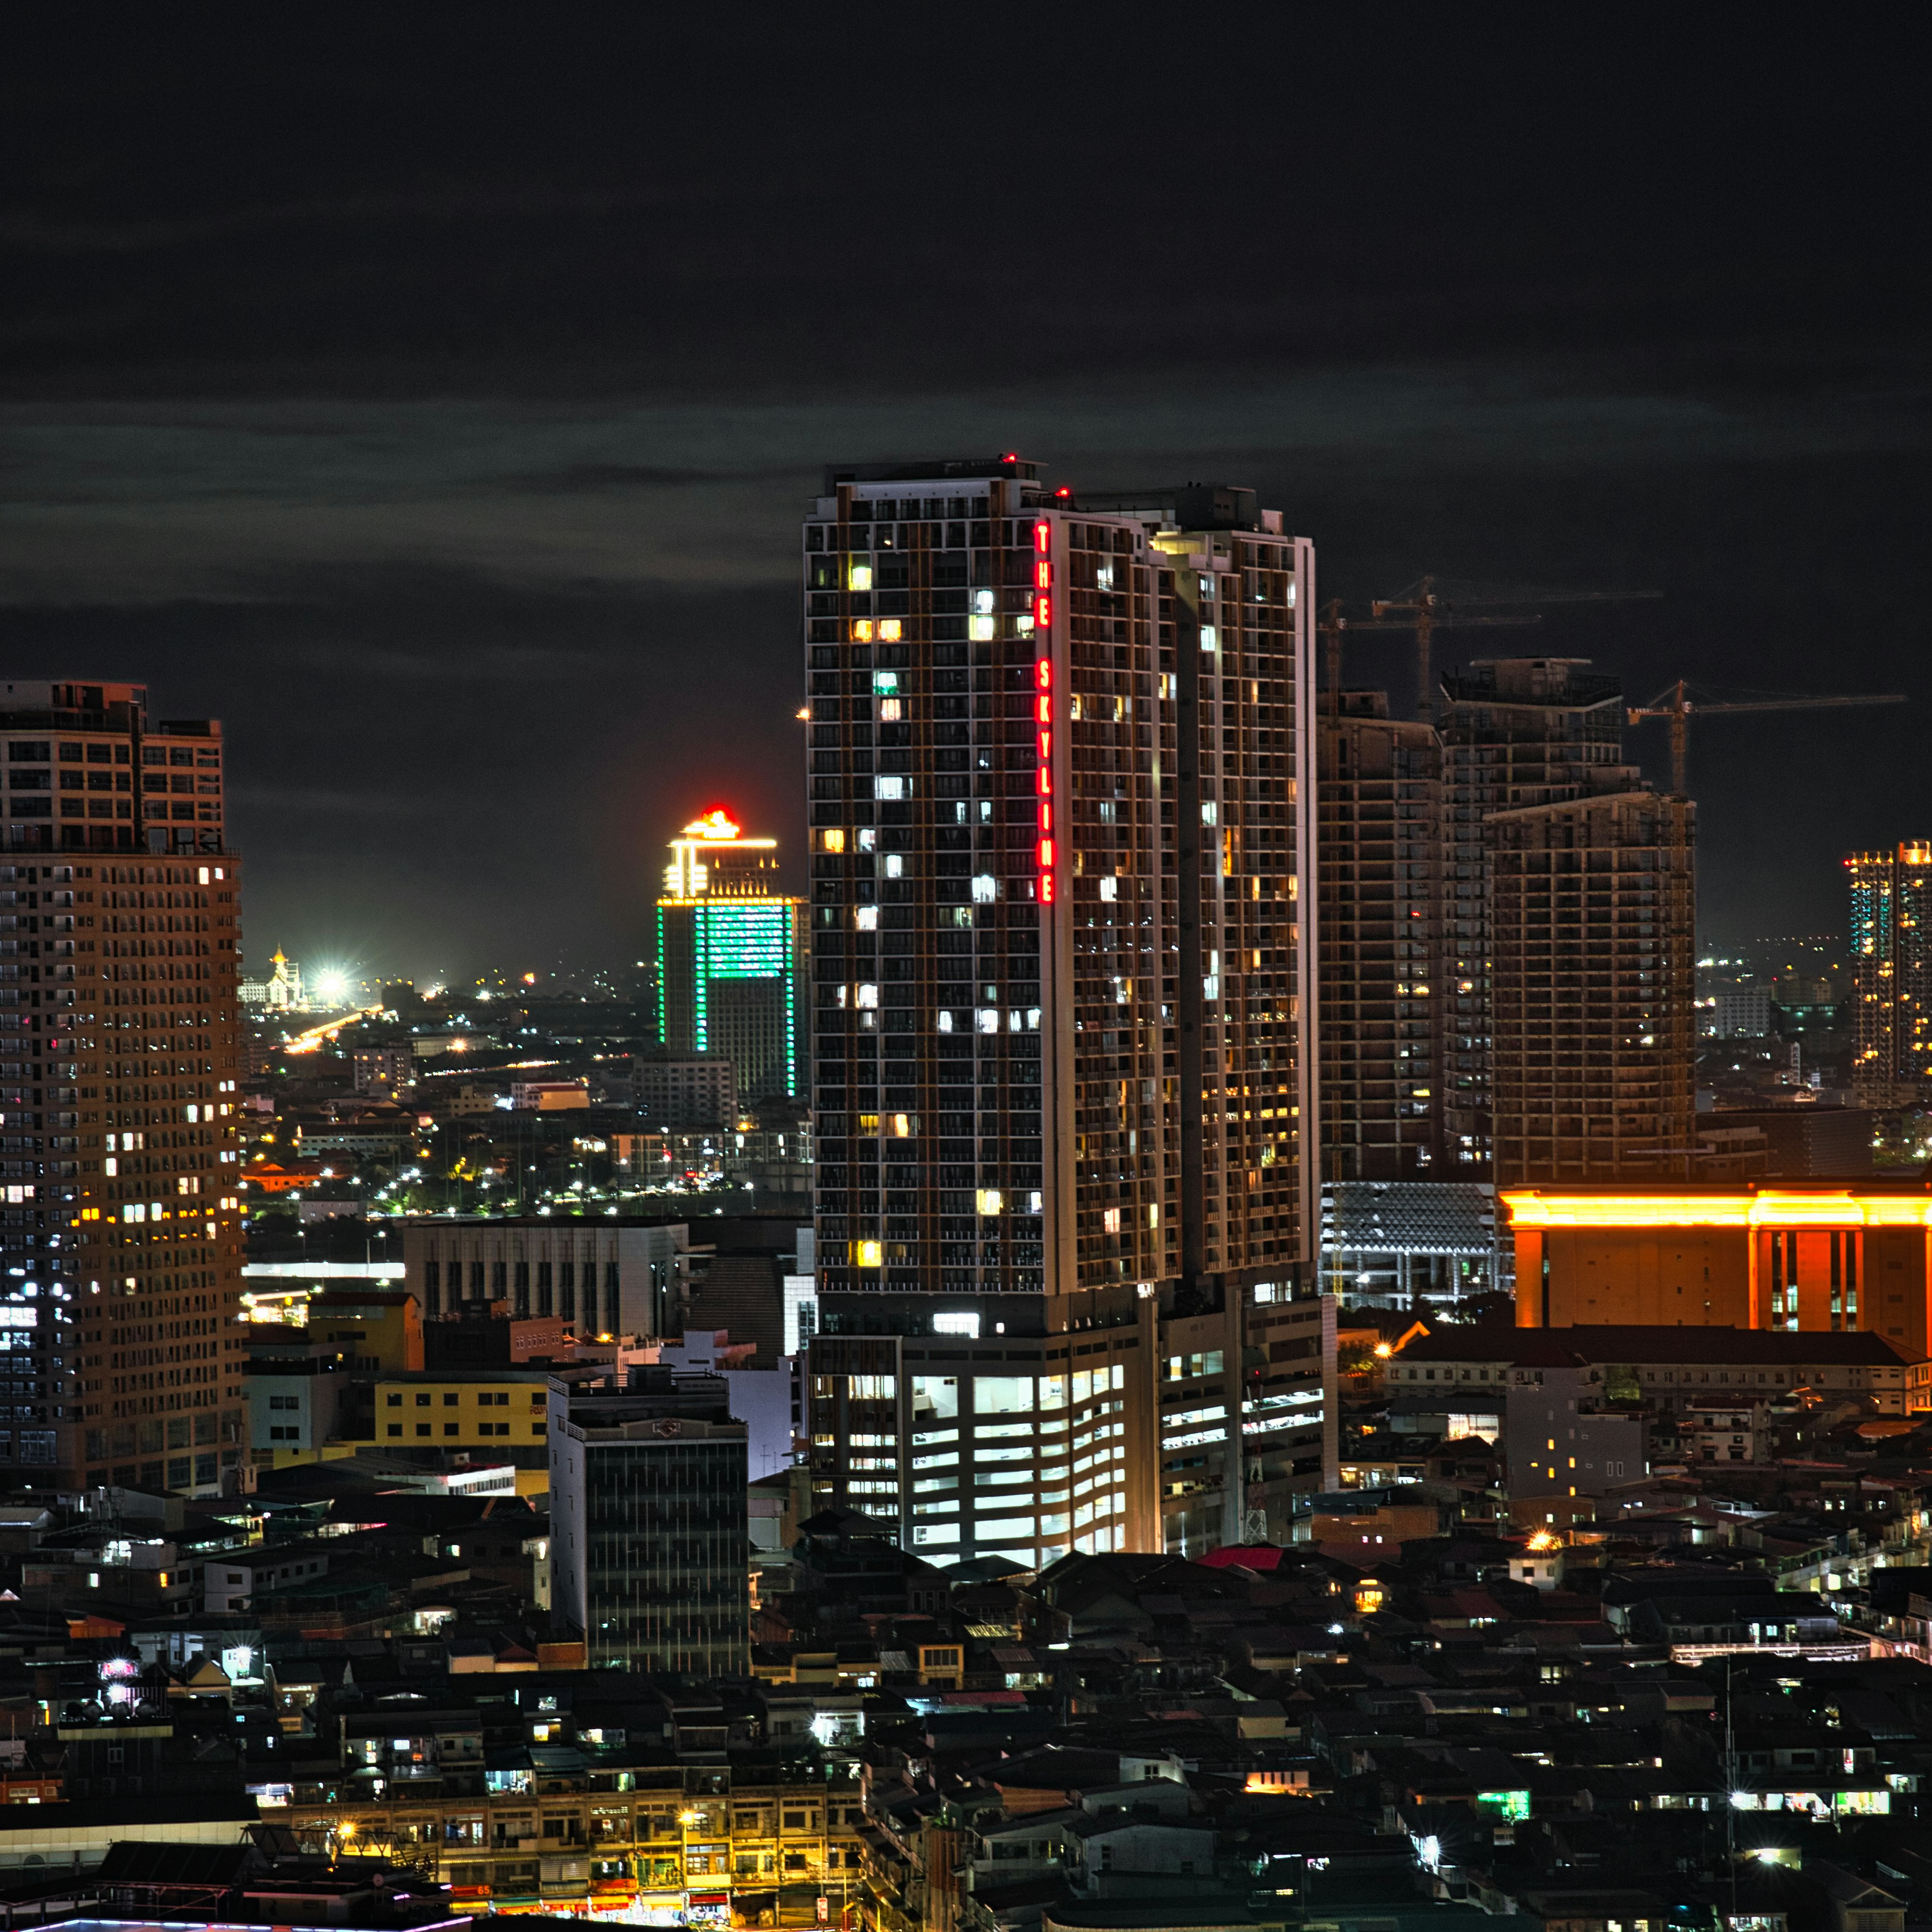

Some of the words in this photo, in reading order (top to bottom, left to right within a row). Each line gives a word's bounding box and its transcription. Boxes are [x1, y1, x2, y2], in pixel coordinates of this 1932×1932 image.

[1036, 524, 1050, 627] THE
[1038, 659, 1053, 903] SKYLINE
[478, 1885, 490, 1895] 65
